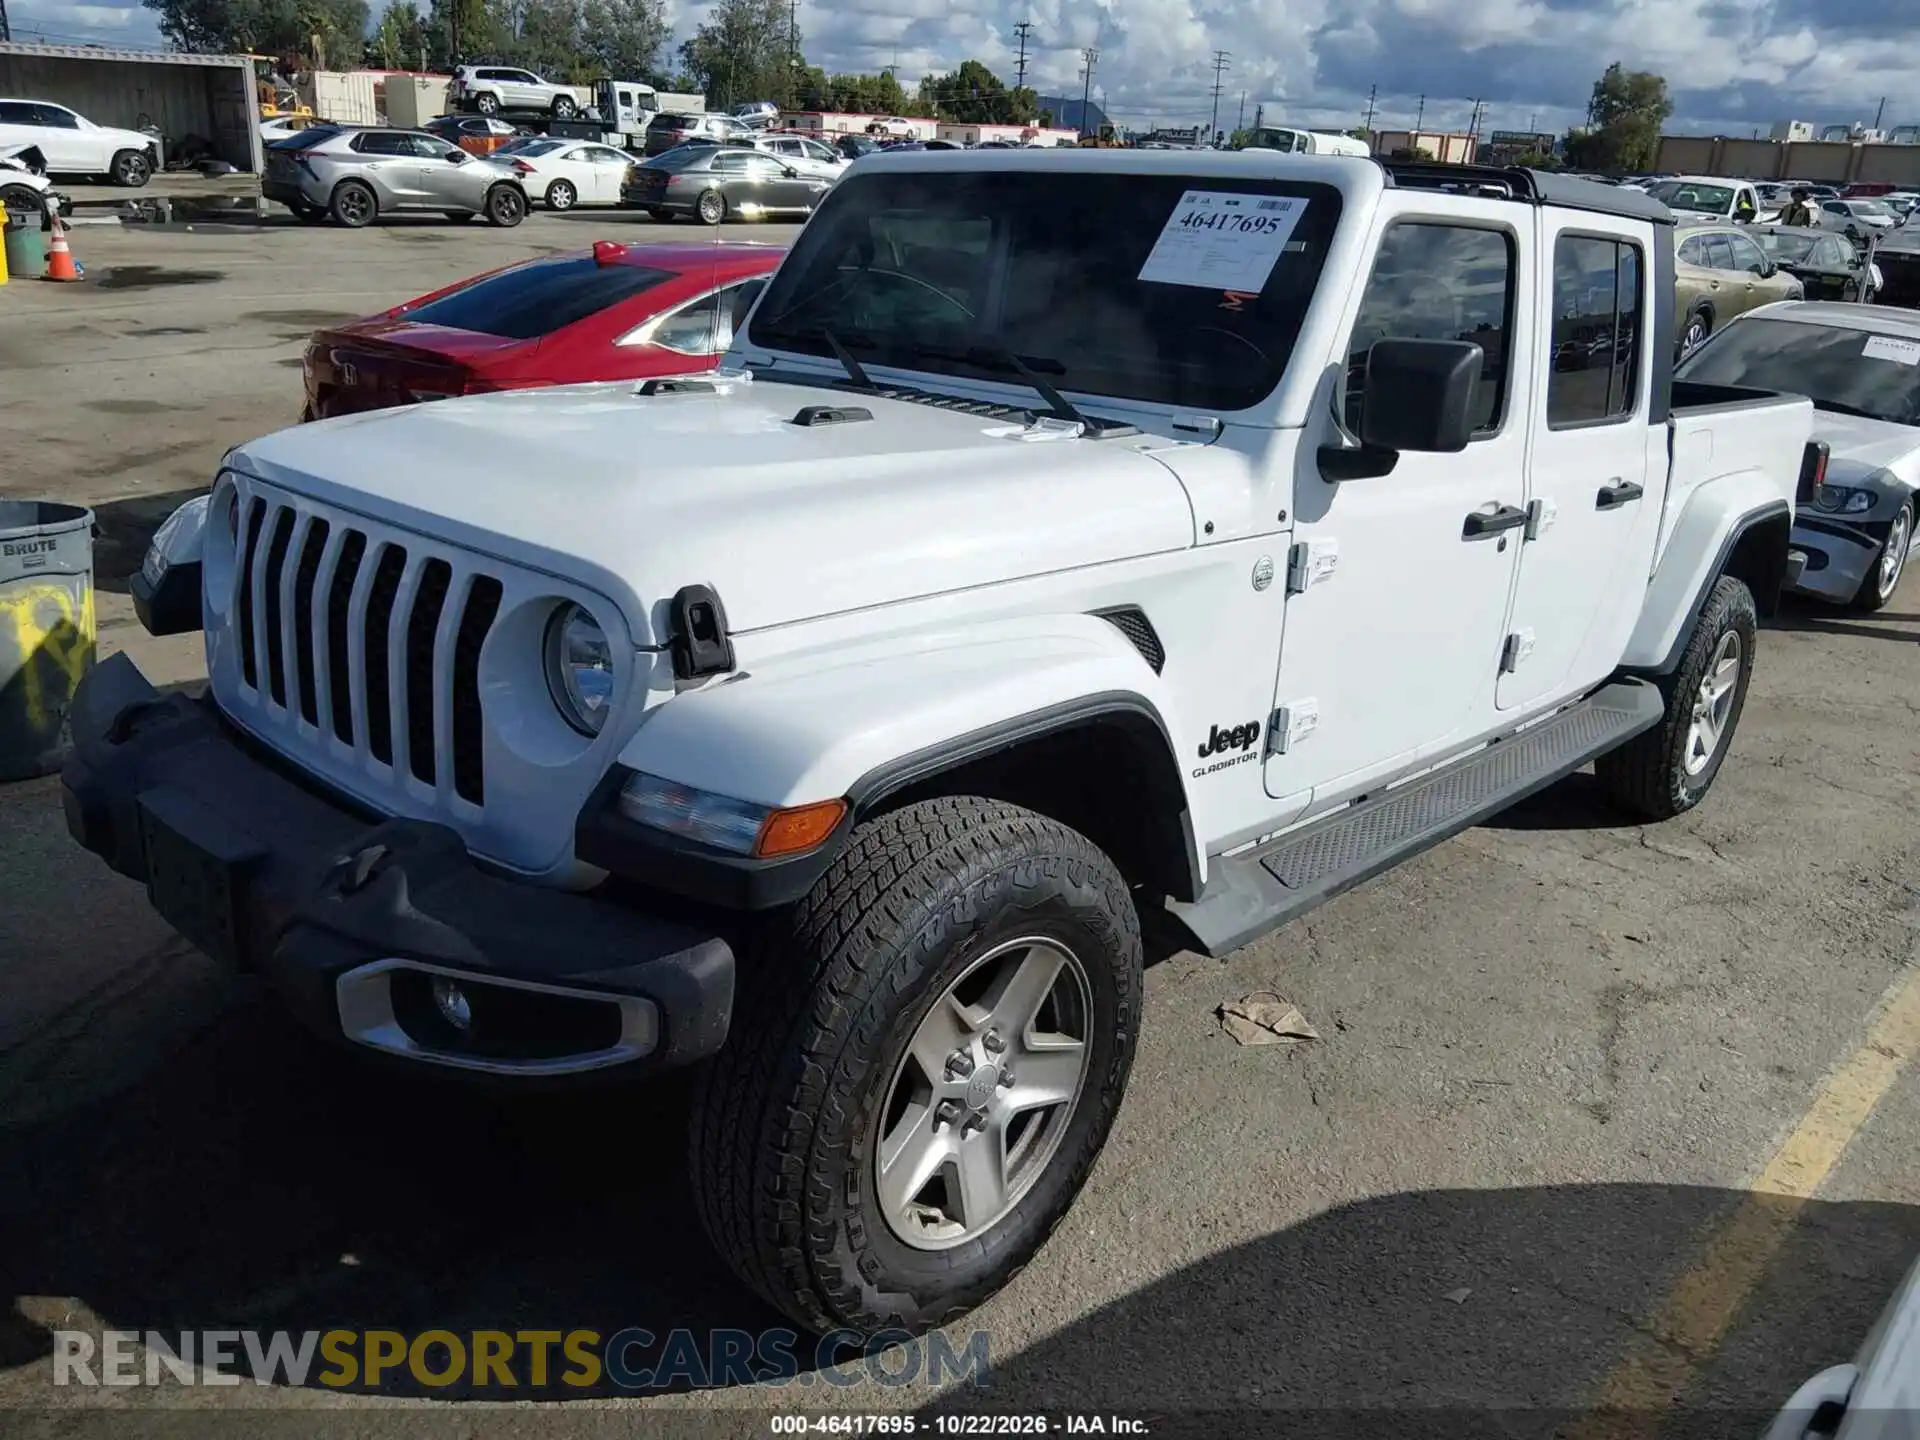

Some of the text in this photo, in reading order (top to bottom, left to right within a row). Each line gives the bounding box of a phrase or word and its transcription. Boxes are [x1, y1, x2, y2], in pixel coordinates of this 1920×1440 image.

[1179, 209, 1281, 234] 46417695
[3, 539, 57, 556] BRUTE
[1198, 720, 1260, 758] Jeep
[1192, 752, 1258, 779] GLADIATOR
